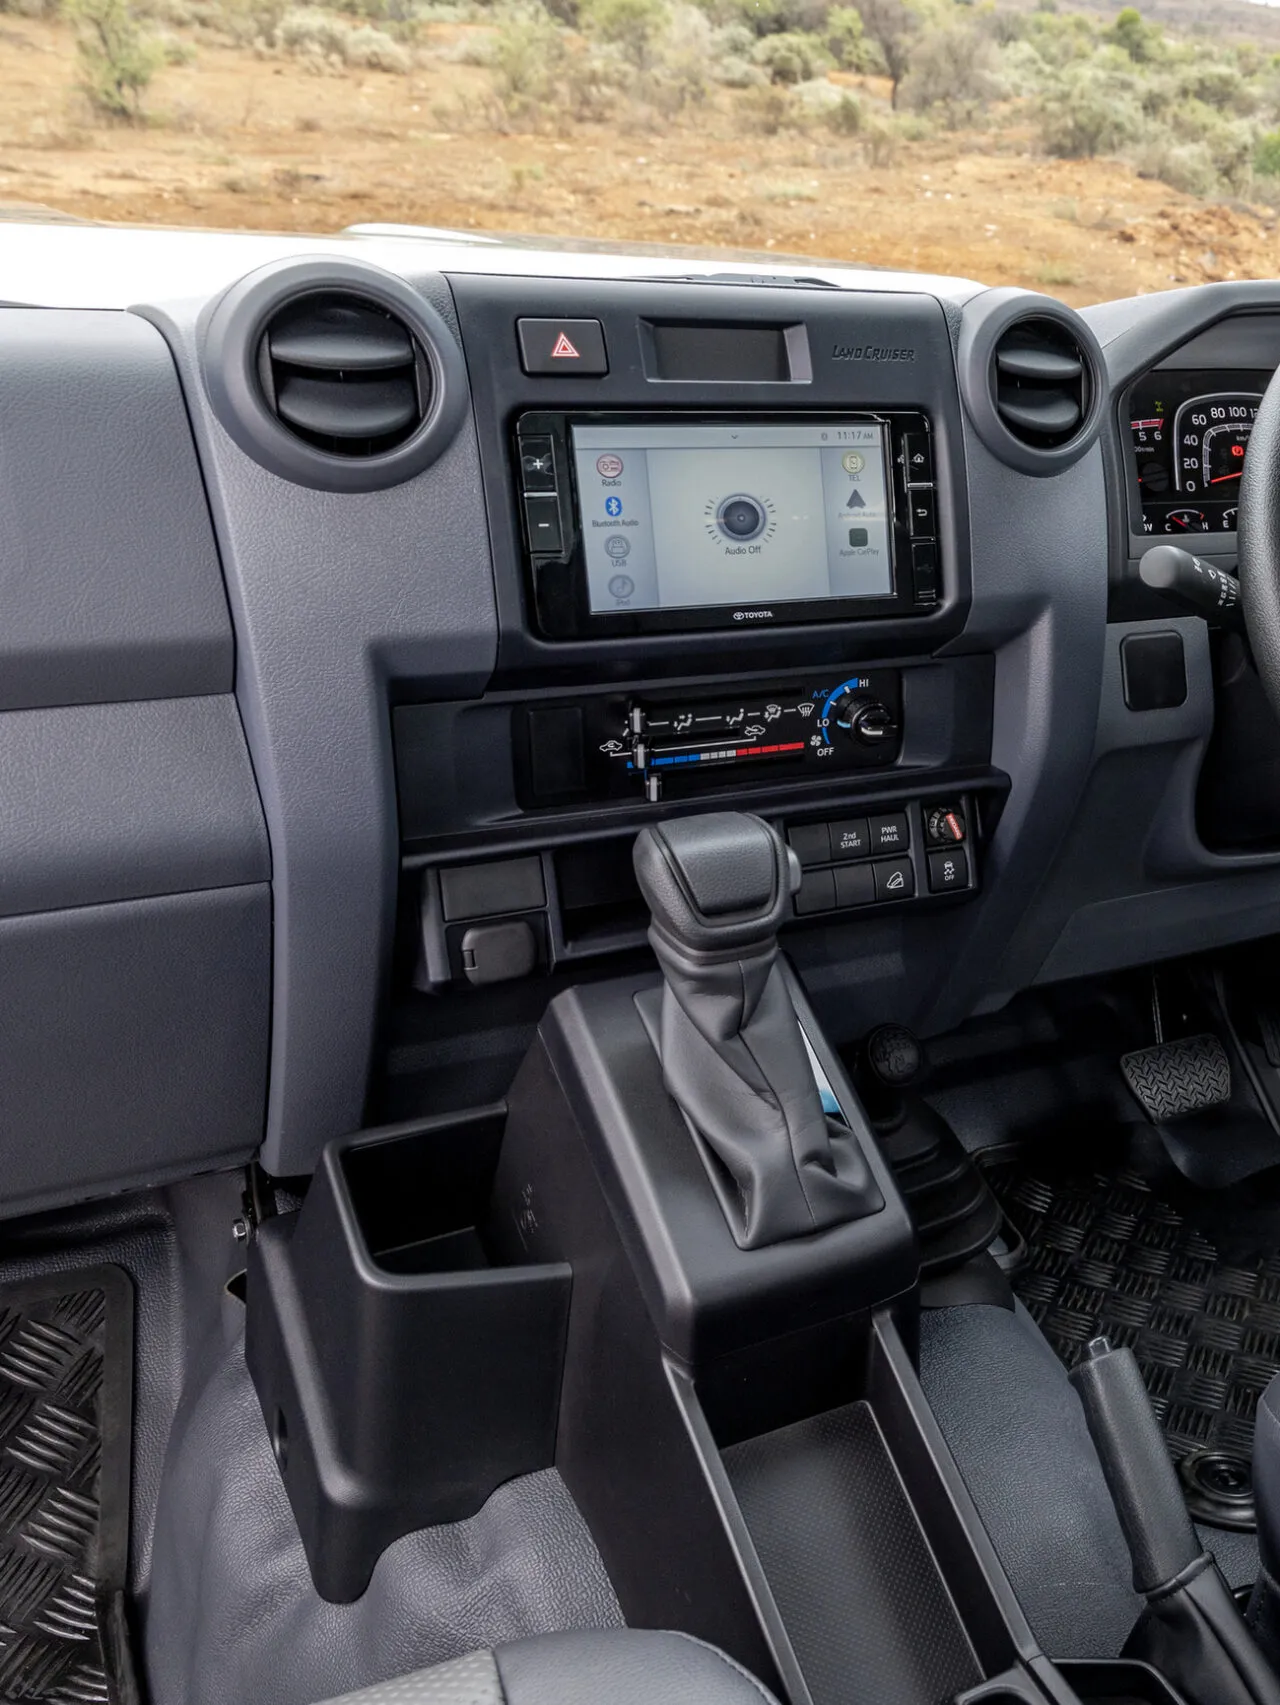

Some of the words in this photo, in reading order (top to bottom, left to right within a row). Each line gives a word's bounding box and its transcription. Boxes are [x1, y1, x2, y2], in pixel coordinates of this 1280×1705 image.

[864, 346, 914, 361] CRUISER
[1210, 408, 1225, 418] 80
[1229, 407, 1247, 417] 100
[1192, 414, 1206, 425] 60
[838, 431, 861, 440] 11:17
[1139, 432, 1147, 440] 5
[1154, 431, 1162, 440] 6
[1184, 435, 1198, 446] 40
[1184, 458, 1198, 469] 20
[601, 479, 622, 487] Radio
[1186, 481, 1196, 491] 0
[622, 519, 640, 527] Audio
[1164, 523, 1172, 531] C
[1202, 522, 1209, 530] H
[1222, 520, 1229, 528] E
[725, 546, 747, 555] Audio
[748, 545, 761, 554] Off
[611, 559, 627, 567] USB
[744, 611, 773, 619] TOYOTA
[859, 679, 869, 687] HI
[812, 689, 829, 699] A/C
[817, 718, 829, 727] LO
[817, 747, 834, 756] OFF
[881, 825, 898, 834] PWR
[842, 832, 857, 840] 2nd
[880, 834, 899, 843] HAUL
[840, 839, 861, 849] START
